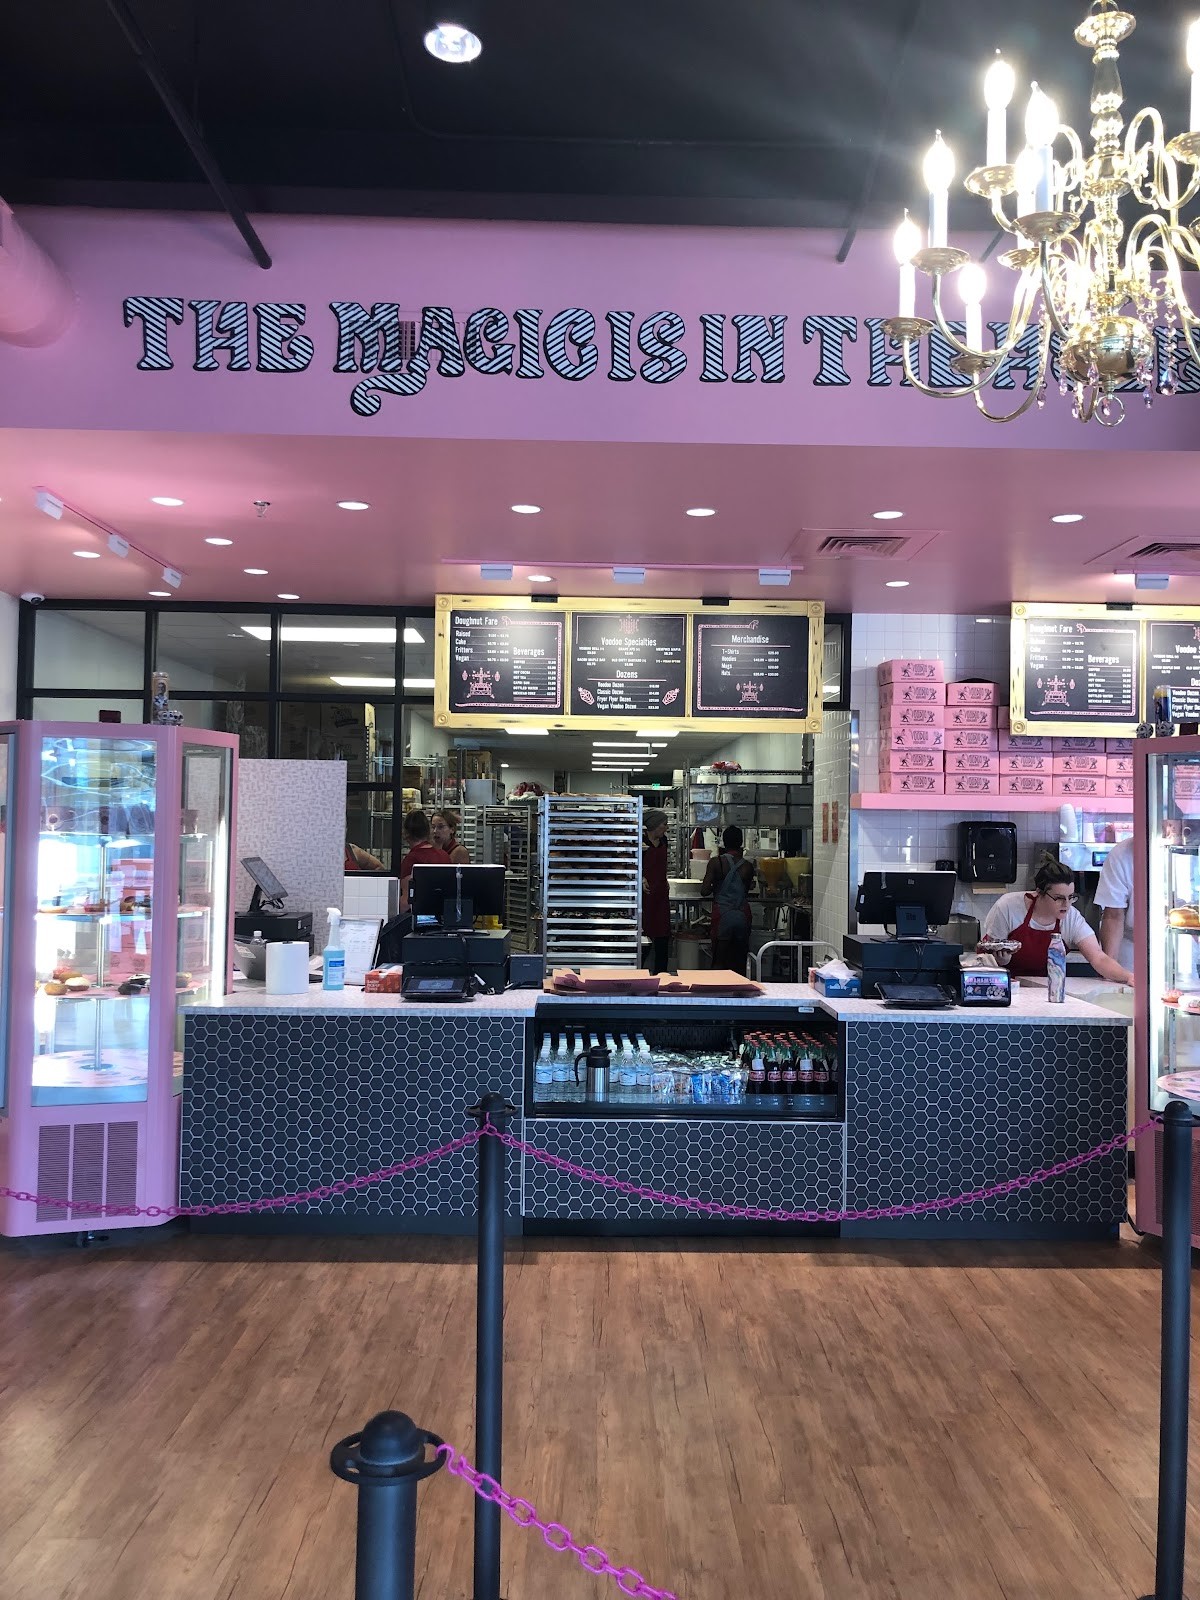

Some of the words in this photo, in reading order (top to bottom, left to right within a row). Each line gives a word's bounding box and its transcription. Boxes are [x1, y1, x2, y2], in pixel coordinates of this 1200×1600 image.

[123, 296, 314, 373] THE
[329, 302, 598, 417] MAGIC
[605, 310, 689, 385] IS
[699, 313, 788, 384] IN
[455, 616, 482, 626] Doughnut
[485, 617, 498, 626] Fare
[601, 637, 622, 646] Voodoo
[624, 637, 656, 646] Specialties
[732, 635, 769, 644] Merchandise
[513, 647, 544, 657] Beverages
[1176, 645, 1197, 653] Voodoo
[1088, 655, 1120, 665] Beverages
[616, 670, 638, 678] Dozens
